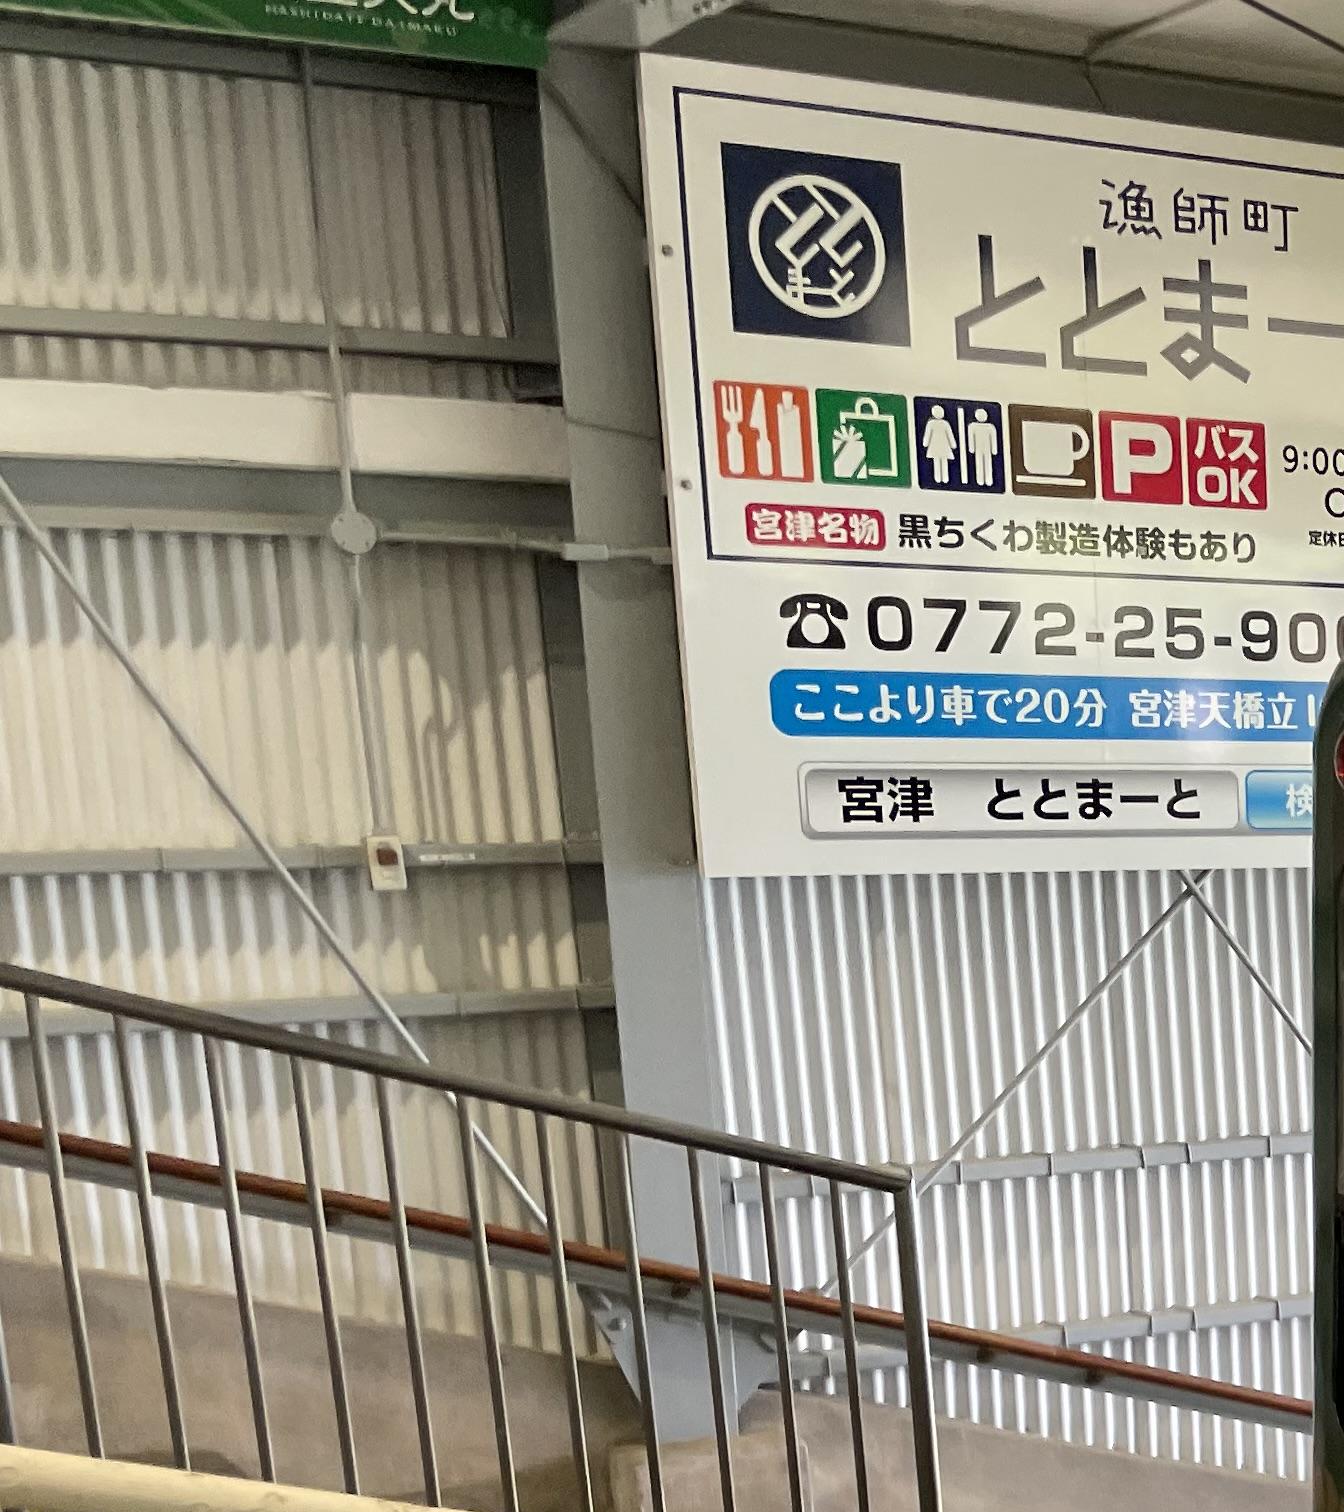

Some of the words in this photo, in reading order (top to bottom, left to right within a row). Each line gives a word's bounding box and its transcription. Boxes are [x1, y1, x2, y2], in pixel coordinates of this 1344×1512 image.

[1100, 178, 1299, 252] 漁師町
[1195, 425, 1259, 463] バス
[1197, 466, 1259, 505] OK
[751, 509, 881, 546] 宮津名物
[898, 513, 1256, 563] 黒ちくわ製造体験もあり
[793, 685, 1107, 728] ここより車で20分
[1128, 689, 1317, 730] 宮津天橋立I
[837, 777, 934, 824] 宮津
[987, 778, 1202, 821] ととまーと
